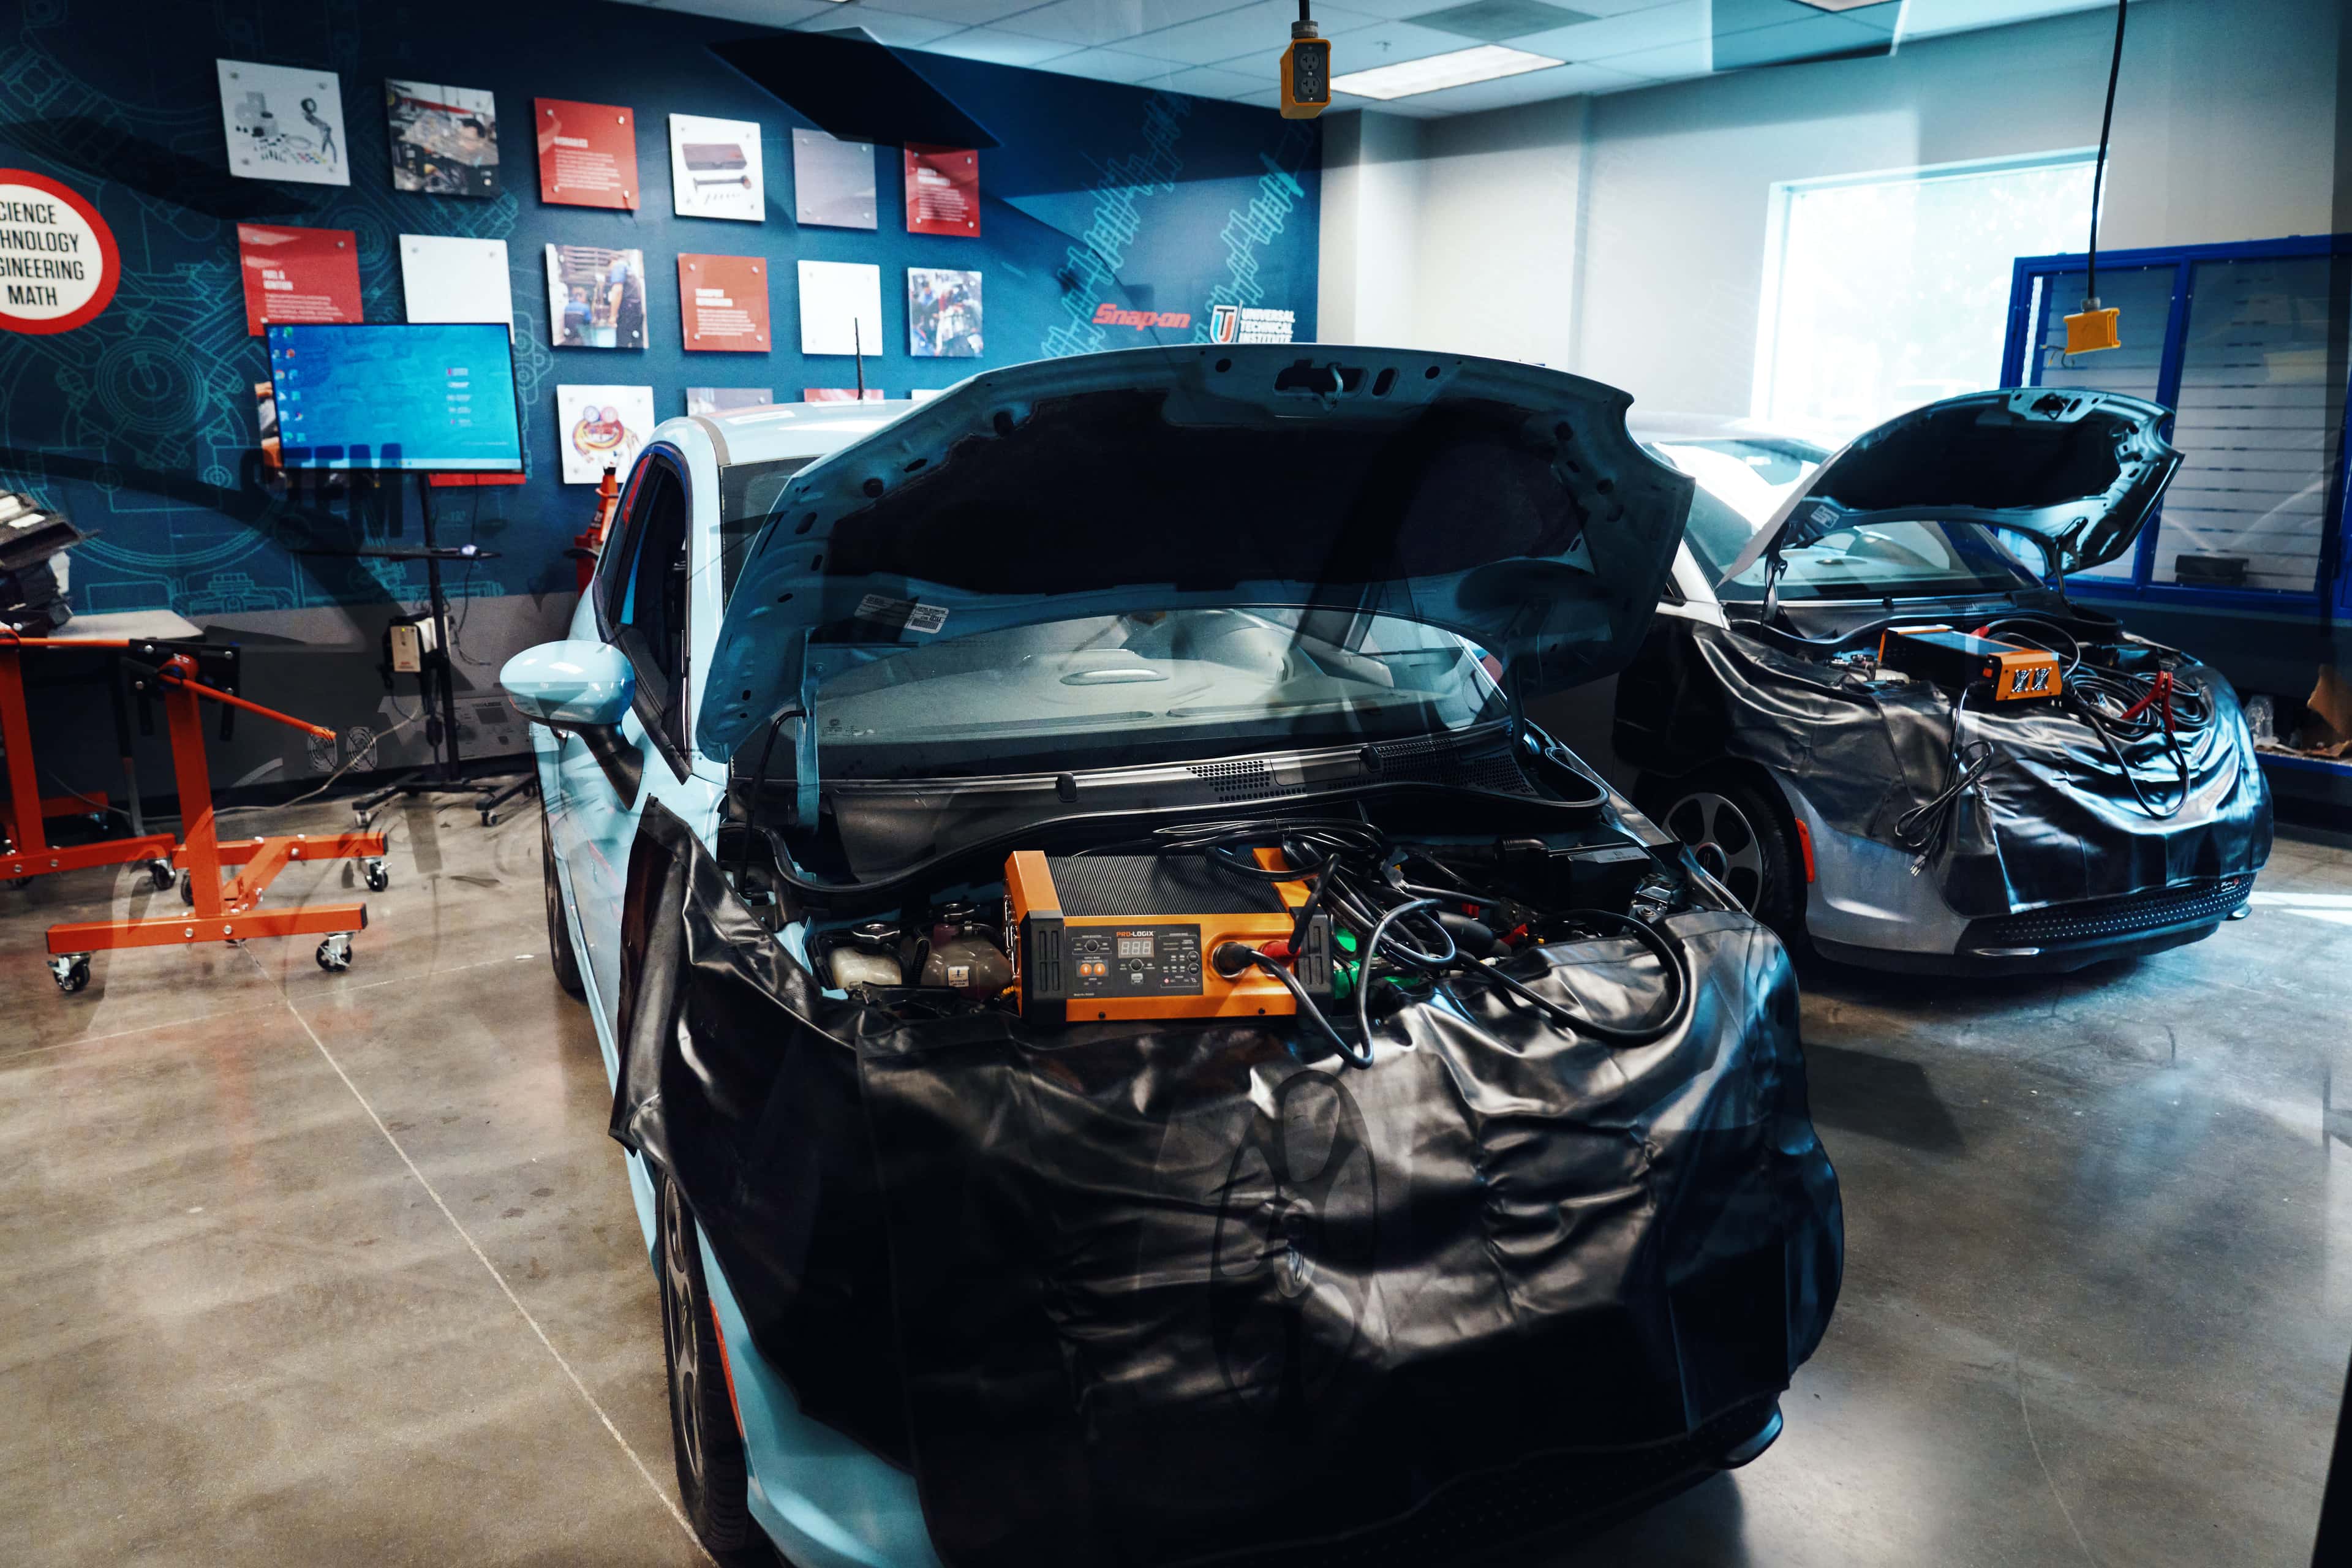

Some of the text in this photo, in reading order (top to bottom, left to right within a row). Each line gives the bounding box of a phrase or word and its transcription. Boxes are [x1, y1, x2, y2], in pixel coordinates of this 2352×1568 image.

[0, 201, 56, 224] CIENCE
[0, 228, 79, 253] HNOLOGY
[0, 257, 85, 280] GINEERING
[7, 285, 58, 306] MATH
[1093, 303, 1191, 331] Snap-on
[1241, 307, 1295, 323] UNIVERSAL
[1240, 320, 1294, 334] TECHNICAL
